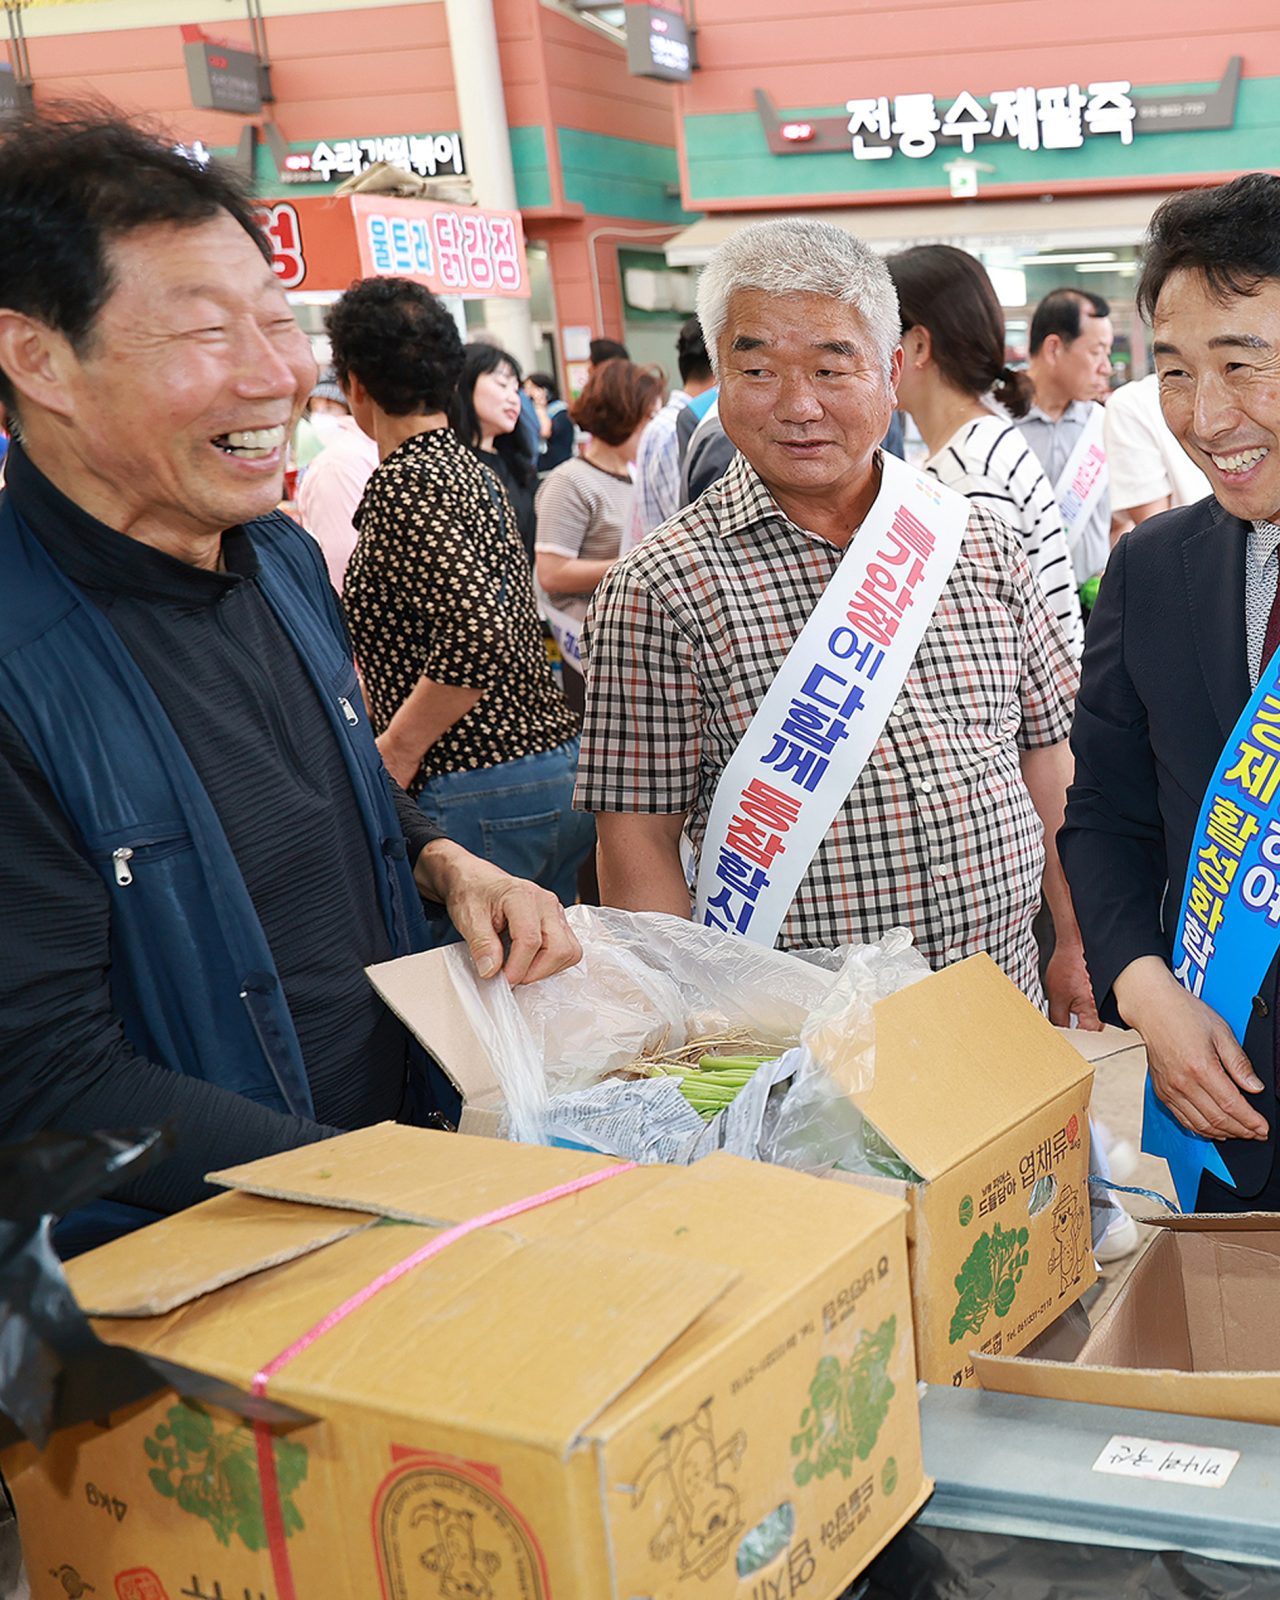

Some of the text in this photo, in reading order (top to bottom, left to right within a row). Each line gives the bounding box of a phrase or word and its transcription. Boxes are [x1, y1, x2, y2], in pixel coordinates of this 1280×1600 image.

[846, 80, 1136, 160] 전통수제팔죽
[369, 213, 520, 288] 울트라 닭강정
[827, 505, 936, 682] 물가안정에
[760, 663, 866, 793] 다함께
[1018, 1127, 1067, 1189] 엽채류
[1109, 1445, 1222, 1476] 미나리 국산
[84, 1481, 128, 1523] 4kg
